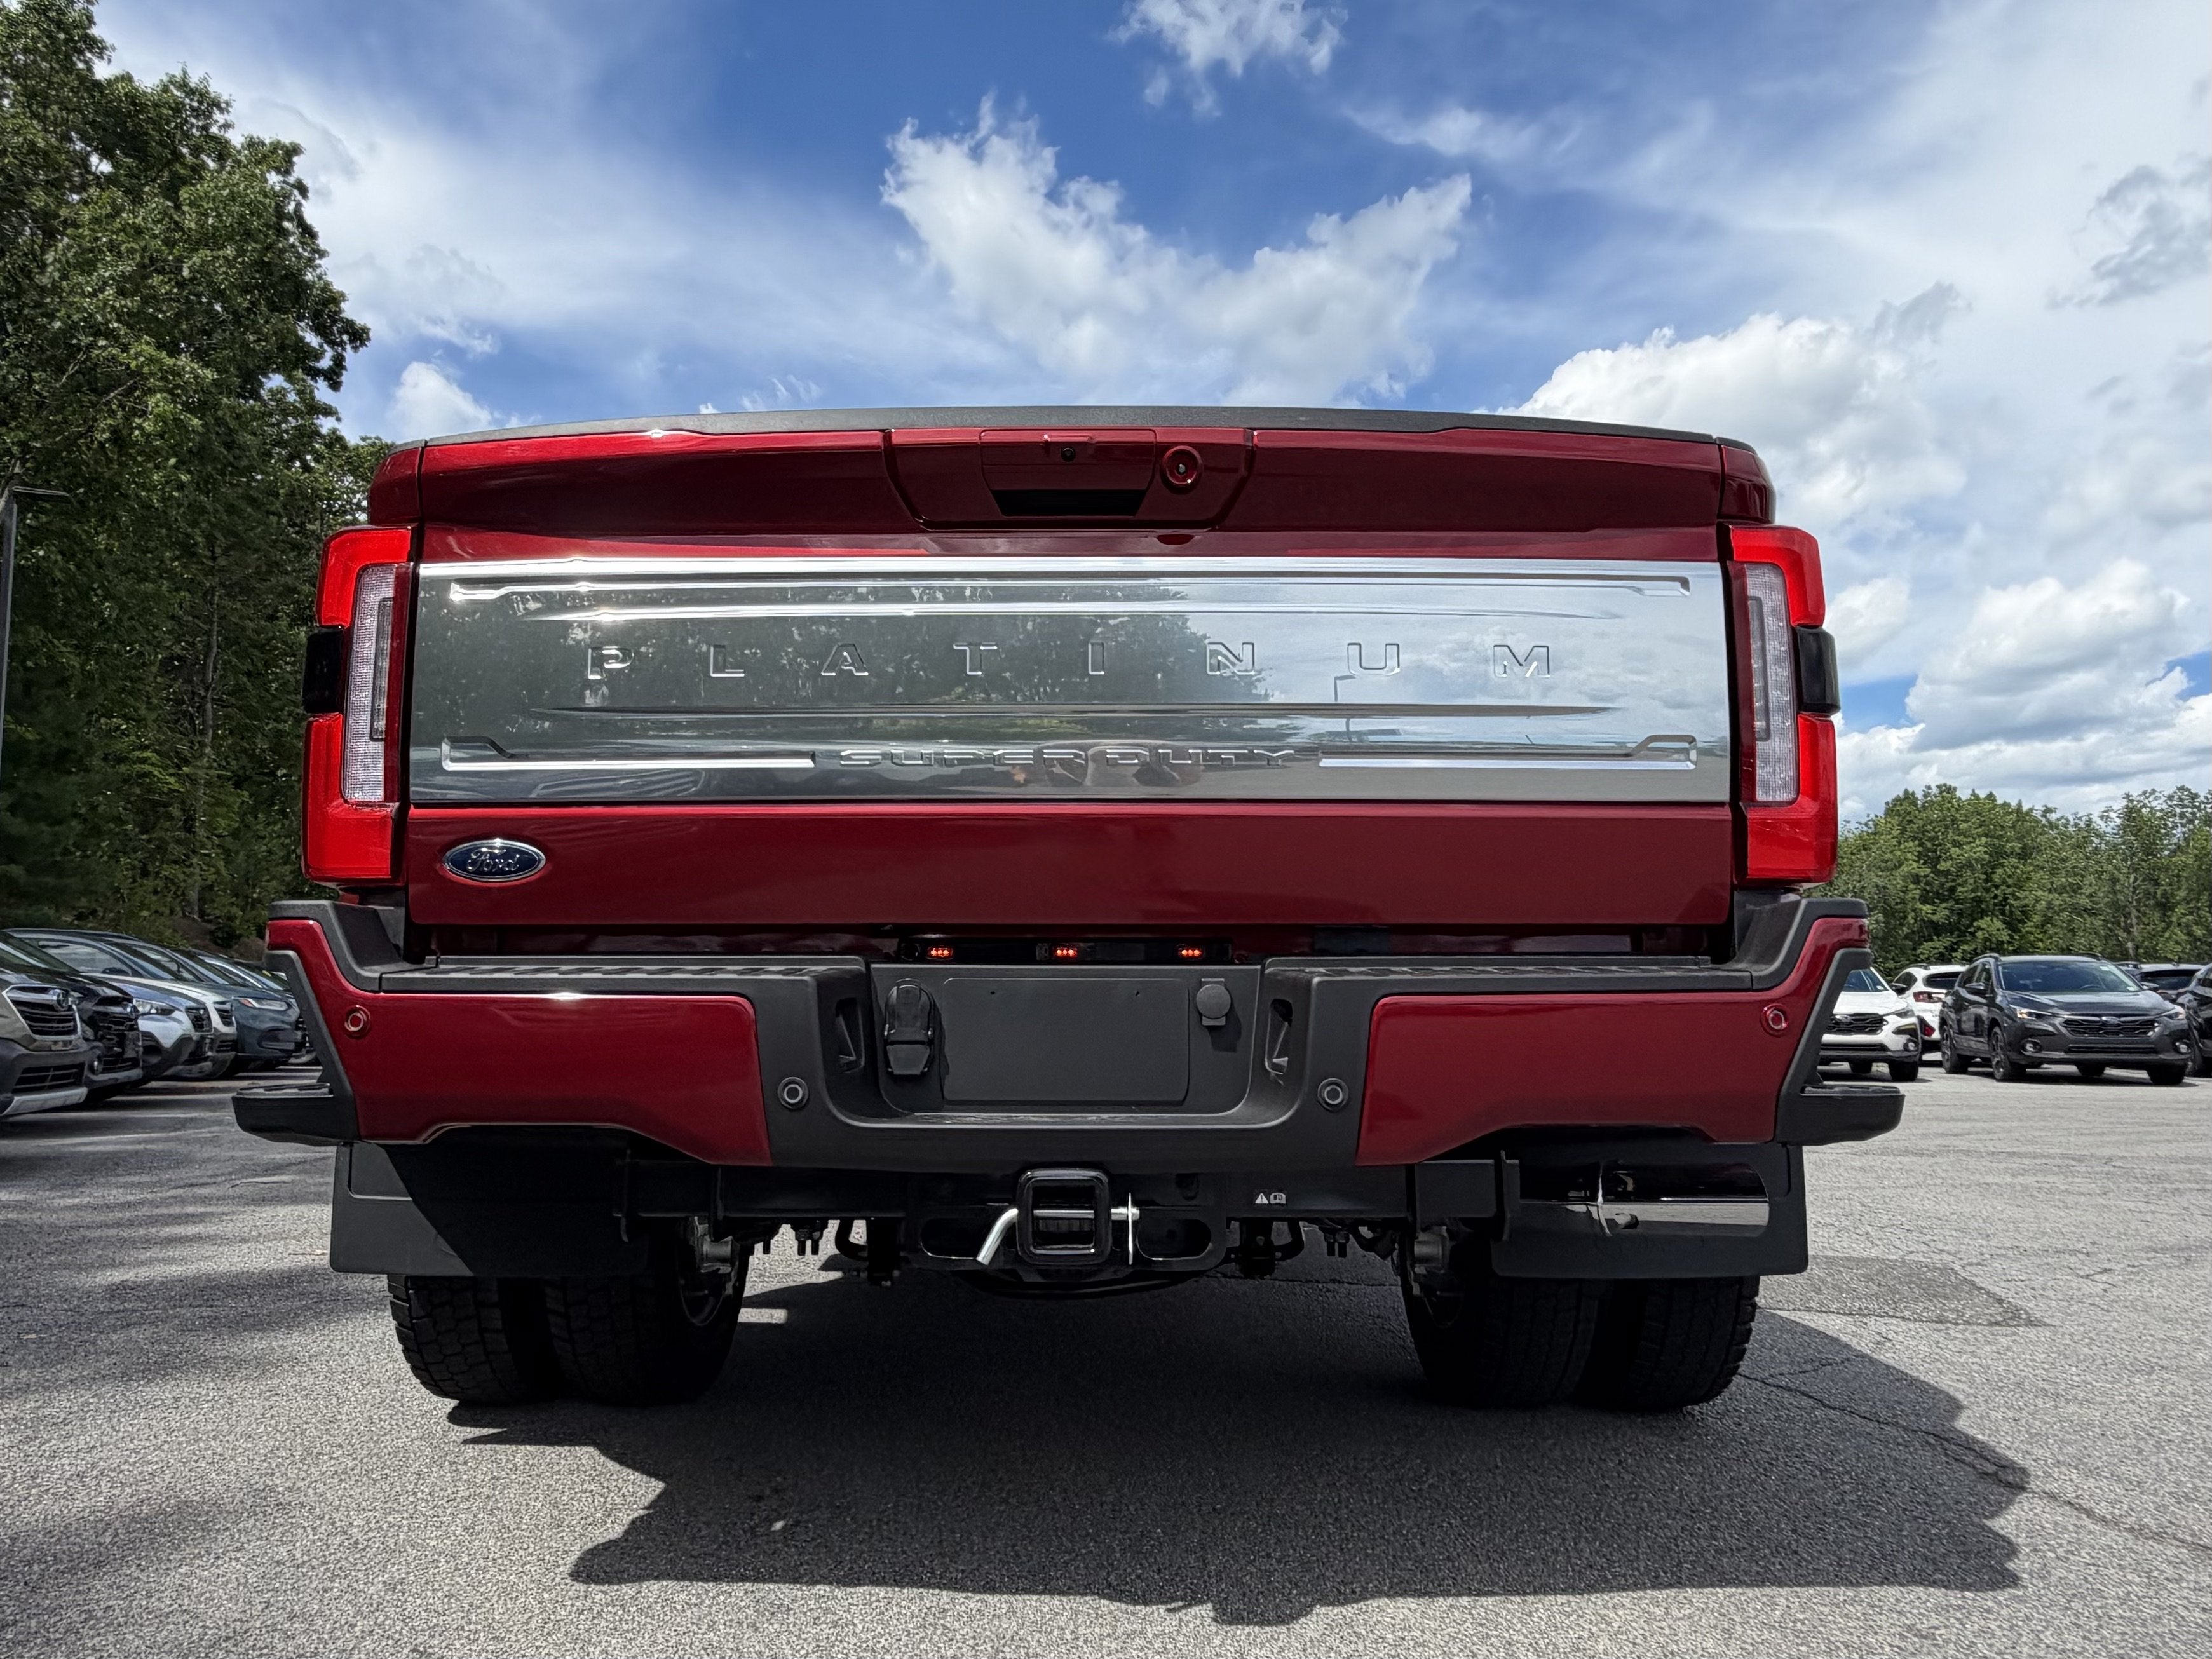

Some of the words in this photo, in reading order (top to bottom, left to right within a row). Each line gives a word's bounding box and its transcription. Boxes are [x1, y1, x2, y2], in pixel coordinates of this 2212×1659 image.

[587, 642, 1551, 680] PLATINUM
[840, 749, 1085, 767] SUPER
[1106, 748, 1295, 767] DUTY
[466, 847, 520, 872] Ford
